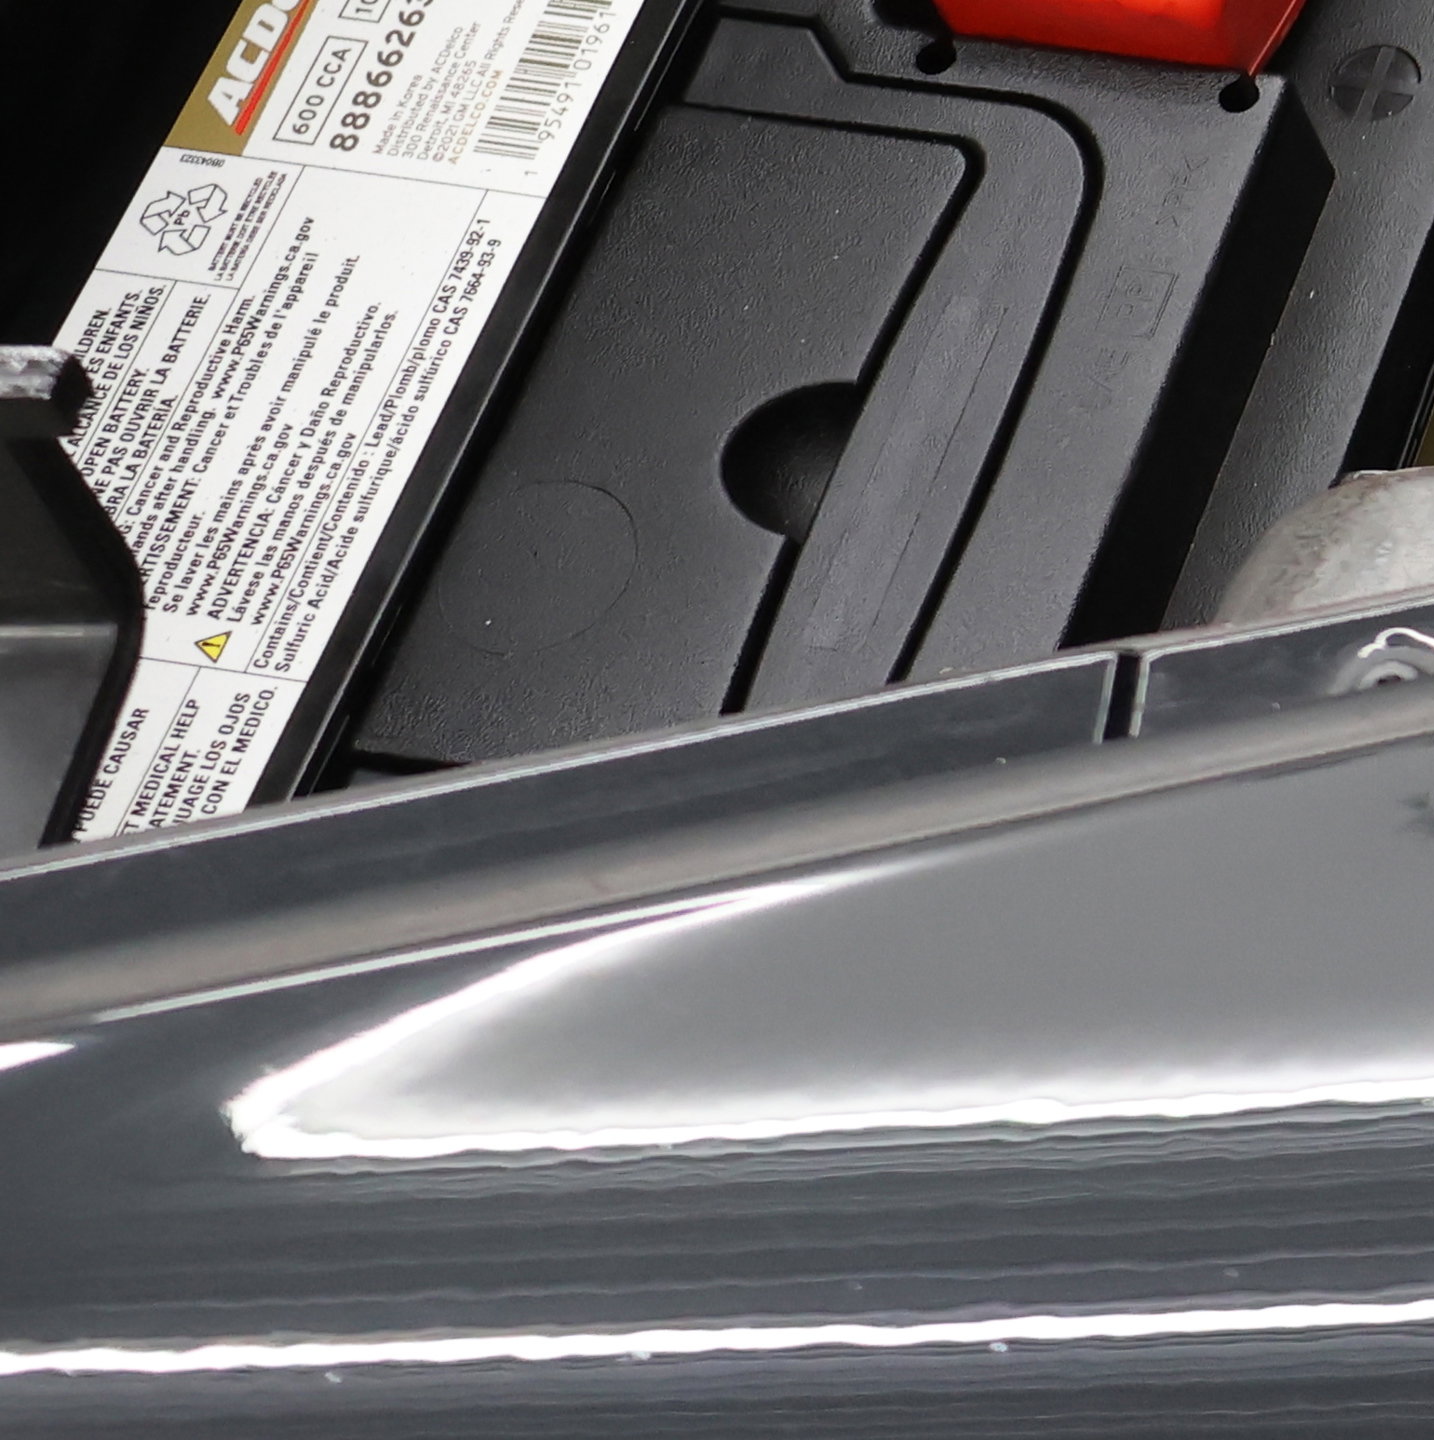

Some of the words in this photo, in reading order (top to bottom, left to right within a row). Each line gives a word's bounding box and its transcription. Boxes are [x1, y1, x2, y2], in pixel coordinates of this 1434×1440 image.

[429, 25, 465, 76] ACDelco
[475, 61, 492, 79] All
[482, 25, 512, 62] Rights
[291, 93, 326, 136] 600
[314, 47, 353, 89] CCA
[395, 73, 424, 109] Korea
[400, 133, 424, 160] 300
[414, 60, 462, 133] Renaissance
[452, 20, 481, 60] Center
[420, 75, 439, 92] by
[461, 78, 484, 102] LLC
[536, 80, 582, 143] 95491
[571, 10, 617, 72] 01961
[385, 92, 430, 158] Distributed
[388, 109, 405, 122] in
[415, 116, 450, 162] Detroit,
[439, 100, 453, 116] MI
[449, 59, 478, 100] 48265
[446, 68, 504, 166] ACDELCO.COM
[451, 102, 470, 123] GM
[371, 122, 398, 156] Made
[172, 208, 192, 227] Pb
[271, 251, 320, 320] l'appareil
[323, 254, 361, 309] produit.
[68, 307, 112, 360] ILDREN.
[93, 291, 141, 355] ENFANTS.
[128, 286, 165, 332] NIÑOS.
[159, 293, 212, 365] BATTERIE.
[220, 294, 256, 336] Harm.
[262, 321, 284, 341] de
[311, 309, 333, 325] le
[100, 361, 125, 382] DE
[112, 332, 140, 361] LOS
[151, 475, 179, 512] after
[167, 407, 218, 474] handling.
[210, 216, 316, 403] www.P65Warnings.ca.gov
[226, 340, 274, 404] Troubles
[279, 326, 323, 394] manipulé
[148, 366, 173, 386] LA
[169, 335, 233, 433] Reproductive
[74, 435, 113, 479] OPEN
[100, 363, 151, 435] BATTERY.
[118, 387, 161, 444] OUVRIR
[130, 394, 179, 463] BATERÍA.
[223, 404, 241, 421] et
[259, 394, 288, 433] avoir
[99, 445, 129, 477] PAS
[157, 434, 182, 463] and
[190, 421, 231, 475] Cancer
[205, 509, 276, 622] ADVERTENCIA:
[264, 451, 304, 505] Cáncer
[298, 400, 331, 439] Daño
[318, 302, 382, 399] Reproductivo.
[225, 570, 266, 624] Lávese
[253, 544, 280, 568] las
[270, 492, 306, 542] manos
[295, 429, 338, 491] después
[327, 408, 349, 427] de
[340, 310, 398, 407] manipularlos.
[236, 434, 268, 477] après
[251, 456, 371, 670] Contains/Contient/Contenido
[363, 316, 442, 449] Lead/Plomb/plomo
[431, 283, 458, 315] CAS
[446, 218, 492, 282] 7439-92-1
[273, 612, 317, 674] Sulfuric
[305, 525, 360, 611] Acid/Acide
[351, 404, 420, 524] sulfurique/ácido
[412, 338, 453, 403] sulfúrico
[441, 305, 470, 336] CAS
[458, 237, 503, 303] 7664-93-9
[118, 462, 143, 482] LA
[124, 464, 165, 517] Cancer
[96, 485, 131, 520] BRA
[184, 422, 295, 617] www.P65Warnings.ca.gov
[211, 478, 245, 524] mains
[129, 478, 199, 588] RTISSEMENT:
[194, 525, 220, 550] les
[249, 431, 358, 629] www.P65Warnings.ca.gov
[139, 511, 206, 613] reproducteur.
[172, 550, 206, 591] laver
[161, 593, 185, 614] Se
[101, 707, 151, 776] CAUSAR
[198, 739, 228, 772] LOS
[216, 691, 252, 737] OJOS
[229, 686, 278, 754] MEDICO.
[129, 743, 182, 818] MEDICAL
[169, 698, 201, 741] HELP
[218, 757, 243, 777] EL
[147, 750, 199, 831] ATEMENT.
[199, 778, 231, 816] CON
